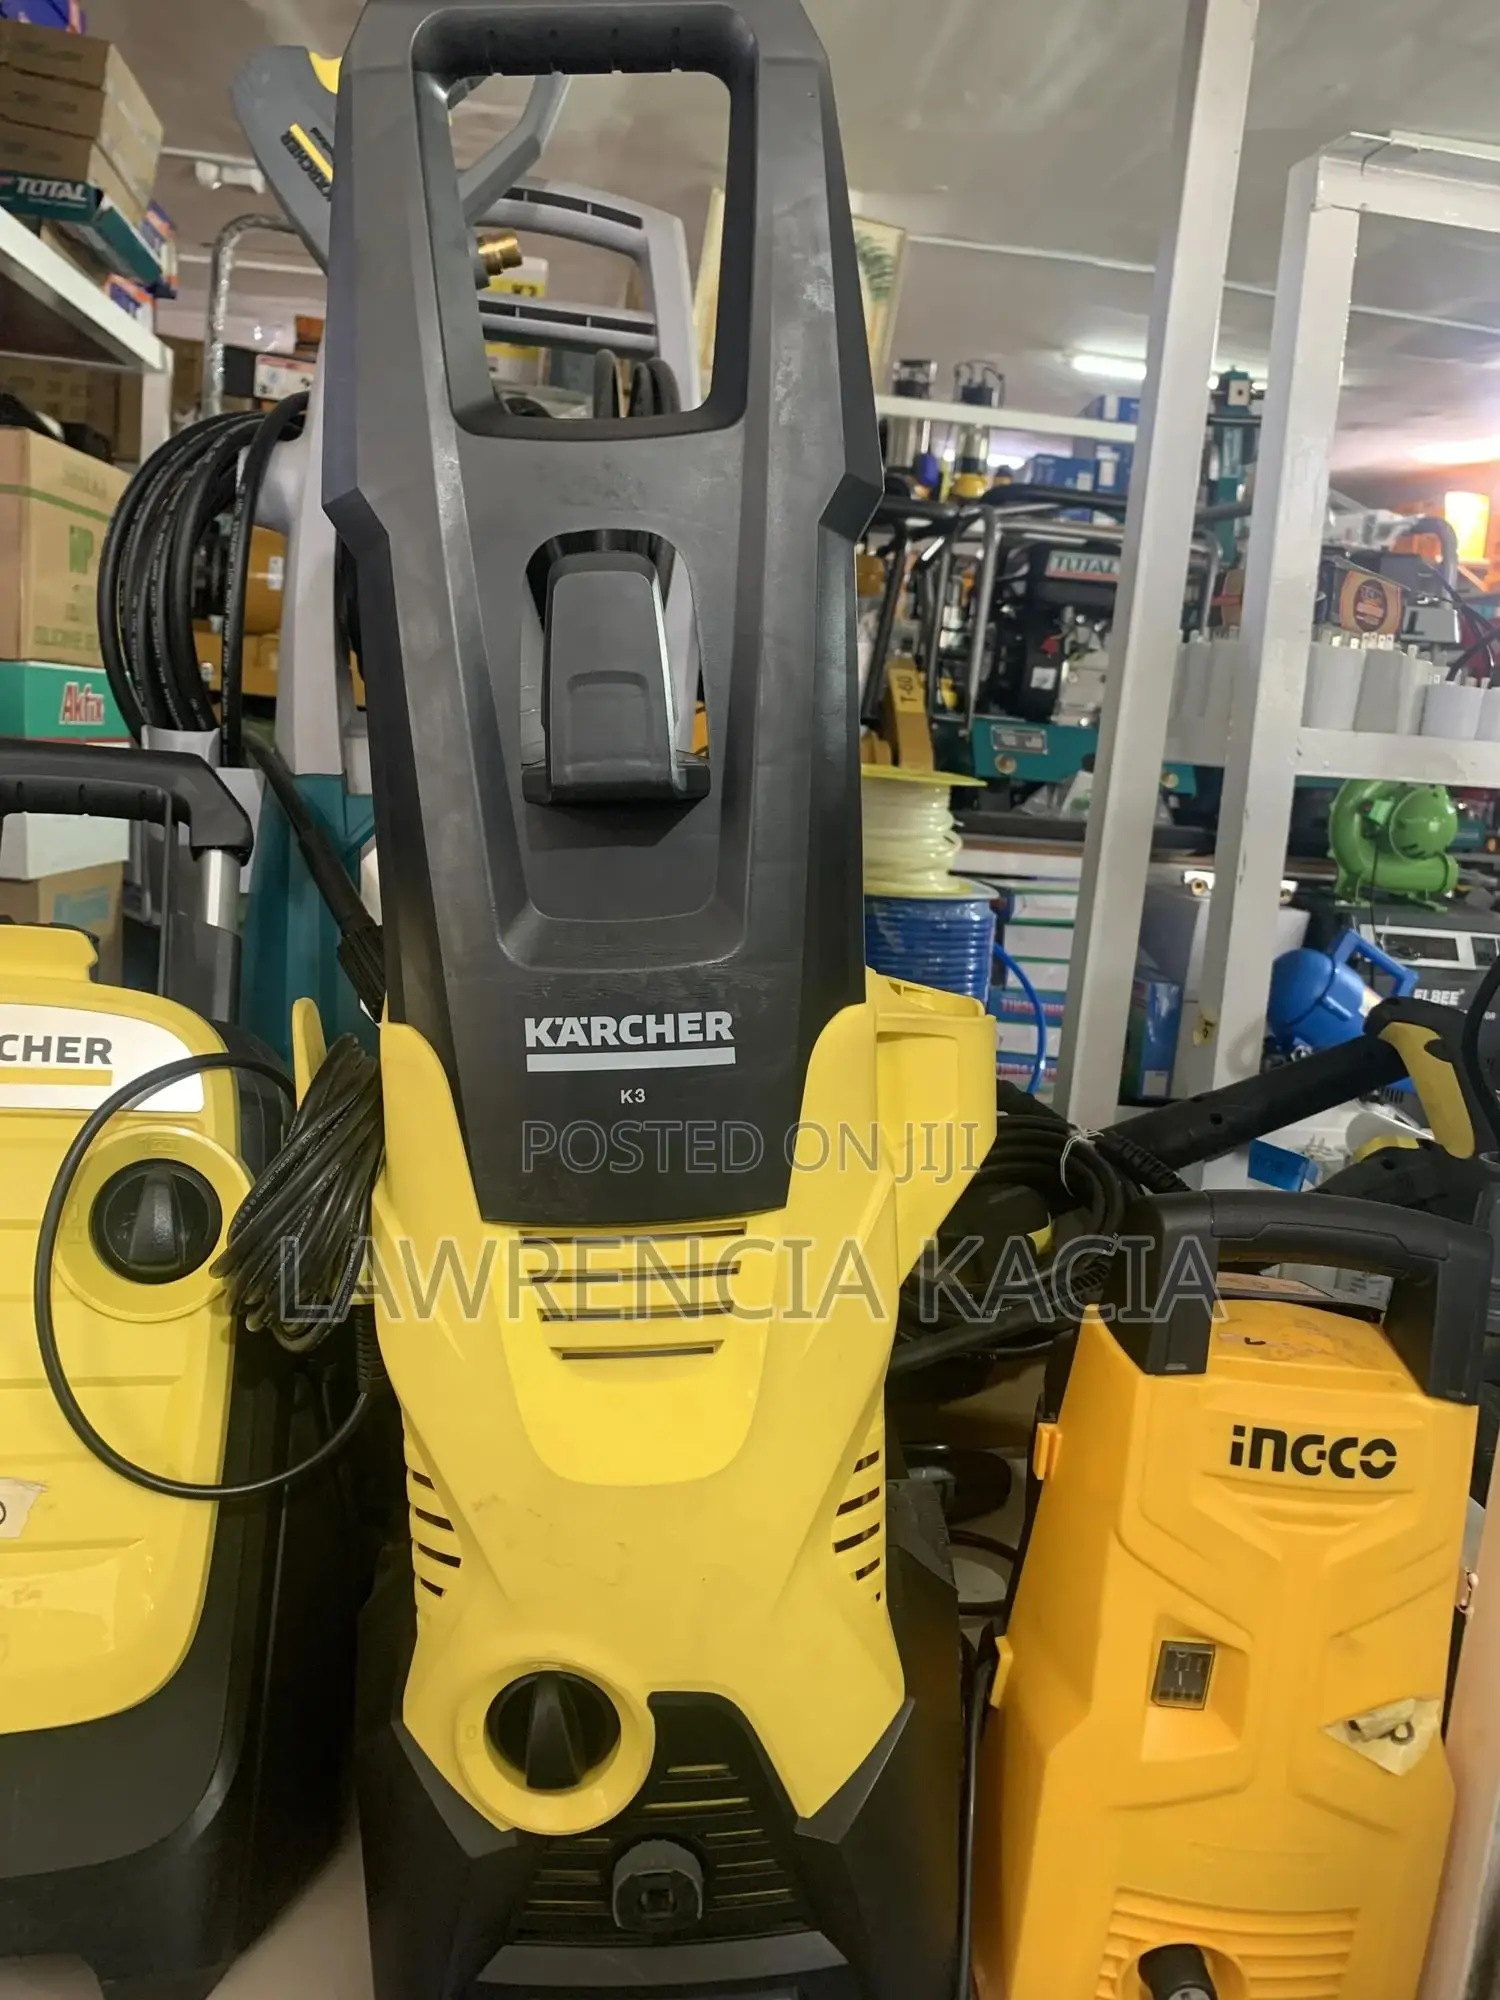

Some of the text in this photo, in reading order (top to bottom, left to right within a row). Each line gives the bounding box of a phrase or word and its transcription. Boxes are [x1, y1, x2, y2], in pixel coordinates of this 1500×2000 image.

[16, 177, 87, 202] TOTAL
[59, 682, 105, 725] Akfix
[524, 1010, 735, 1047] KÄRCHER
[620, 1088, 646, 1104] K3
